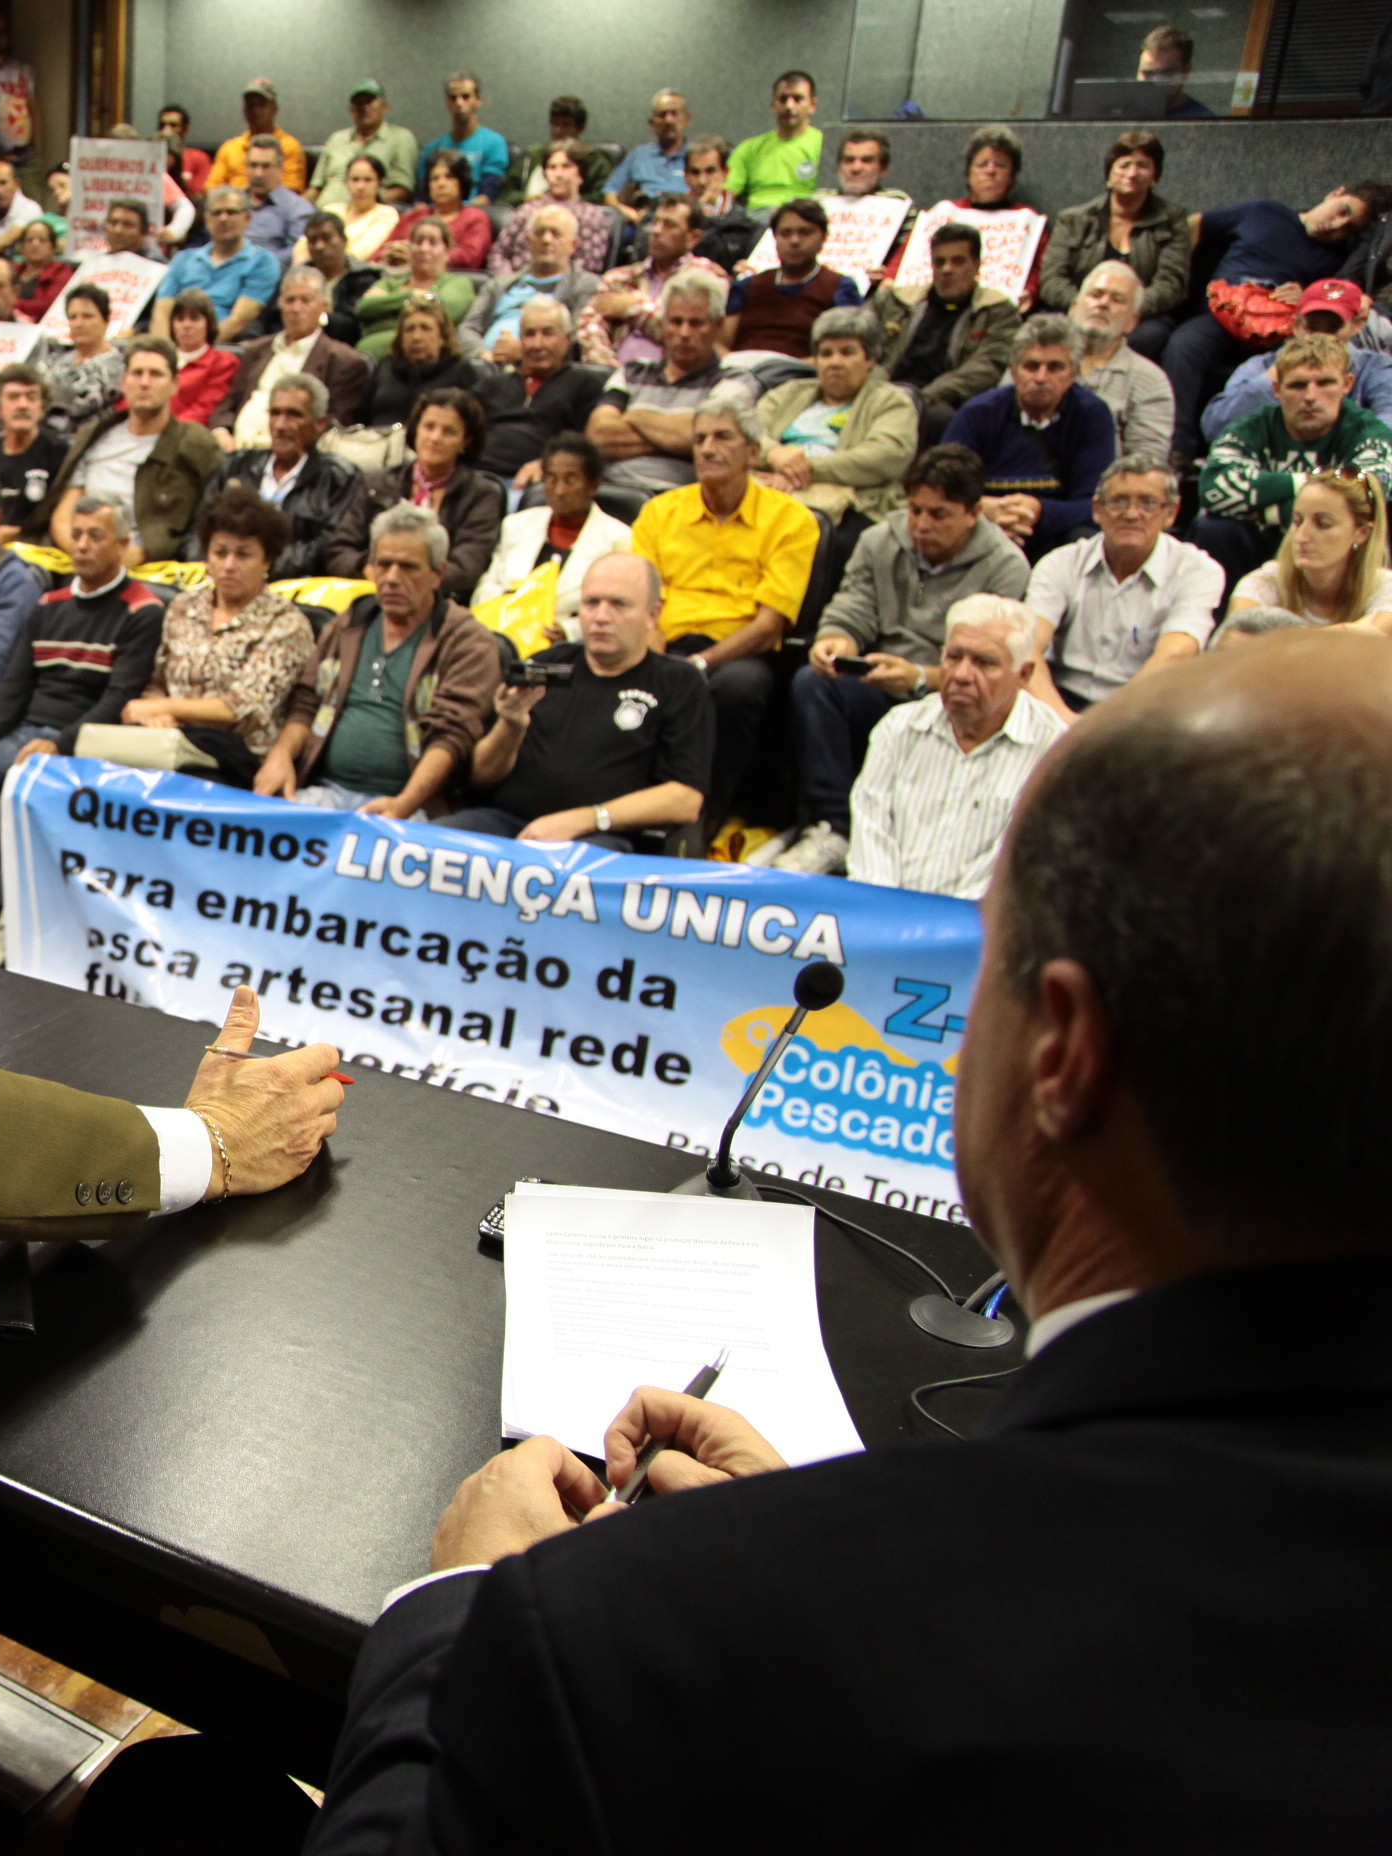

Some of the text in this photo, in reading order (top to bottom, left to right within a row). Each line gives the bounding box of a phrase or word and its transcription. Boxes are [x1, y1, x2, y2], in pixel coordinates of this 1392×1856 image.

[59, 849, 678, 1011] Para embarcação da
[67, 786, 846, 966] Queremos LICENÇA ÚNICA
[87, 927, 692, 1086] esca artesanal rede
[773, 1042, 956, 1116] Colônia
